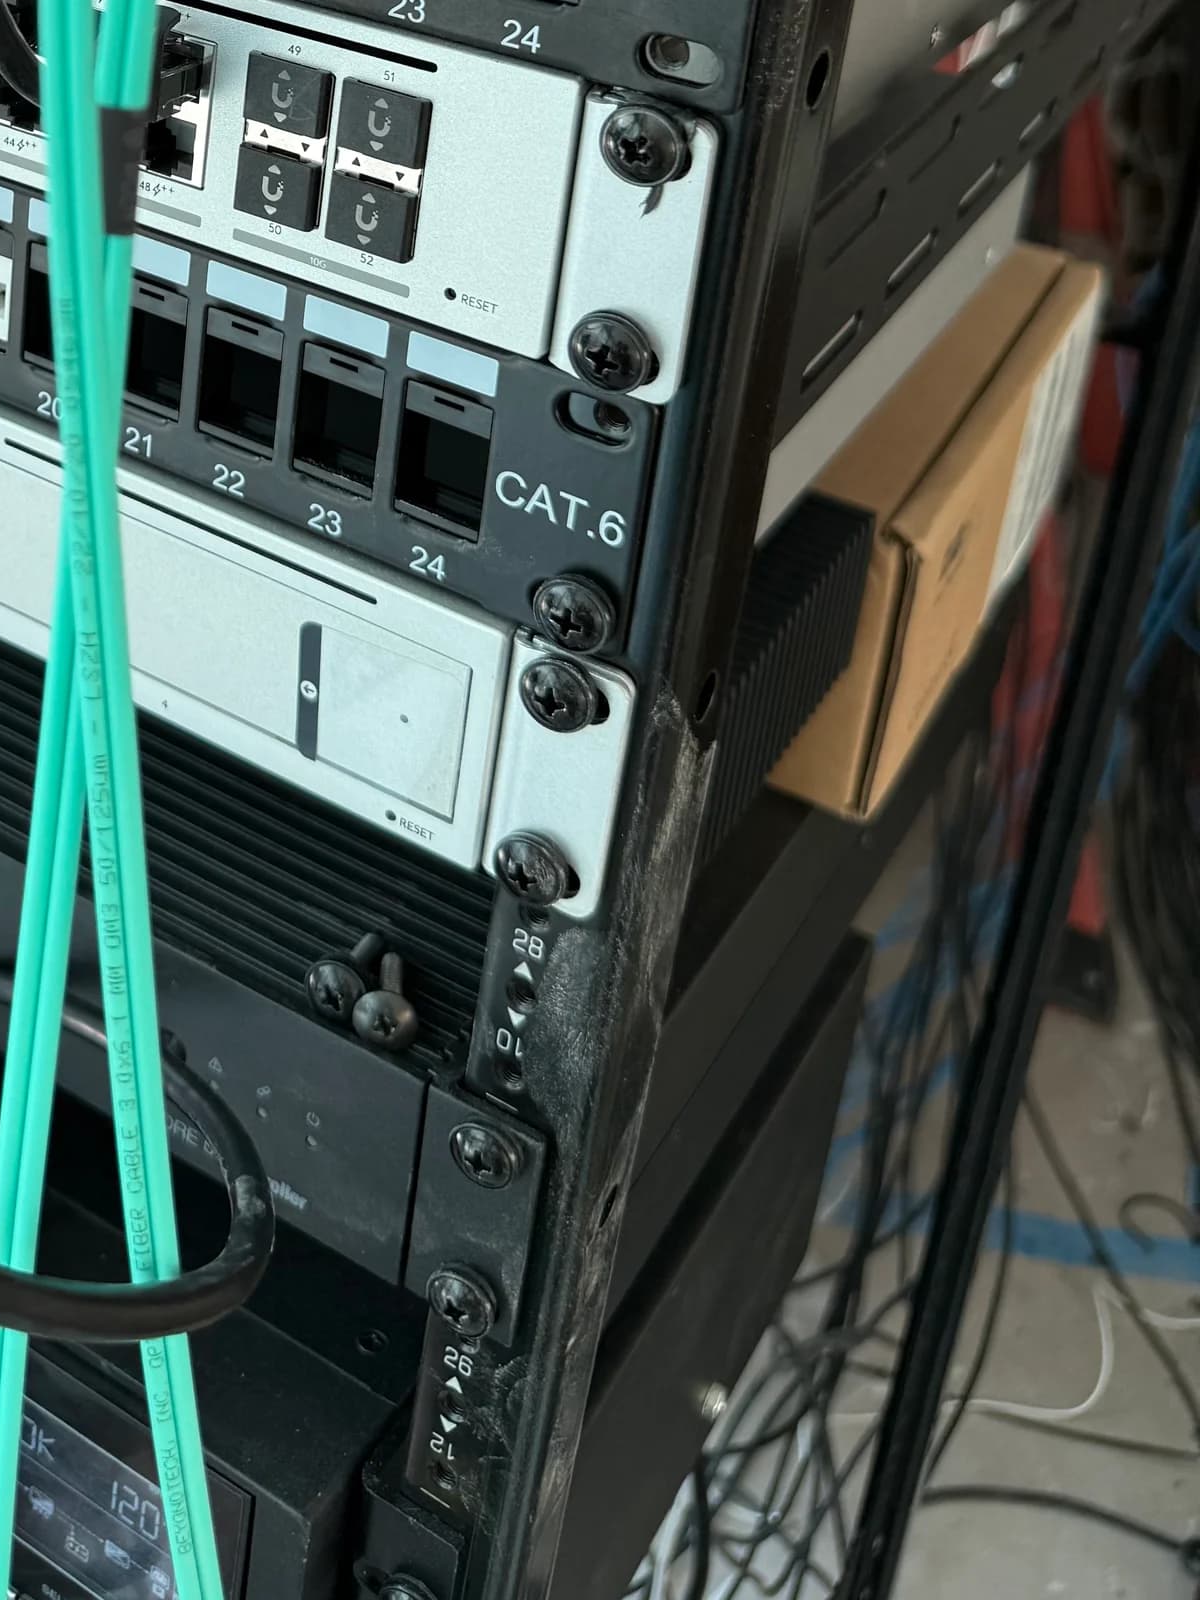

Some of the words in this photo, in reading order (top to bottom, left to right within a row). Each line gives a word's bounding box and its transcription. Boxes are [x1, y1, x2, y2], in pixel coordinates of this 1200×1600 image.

[499, 18, 542, 55] 24
[287, 43, 302, 57] 49
[382, 70, 396, 83] 51
[268, 223, 283, 236] 50
[359, 253, 375, 267] 52
[460, 293, 499, 315] RESET
[36, 390, 64, 421] 20
[124, 425, 153, 459] 21
[211, 462, 246, 499] 22
[307, 501, 343, 537] 23
[408, 544, 447, 582] 24
[494, 469, 628, 550] CAT.6
[398, 816, 438, 842] RESET
[101, 902, 123, 951] OM3
[511, 926, 545, 960] 28
[120, 1125, 144, 1195] CABLE
[129, 1207, 152, 1272] FIBER
[443, 1345, 473, 1375] 26
